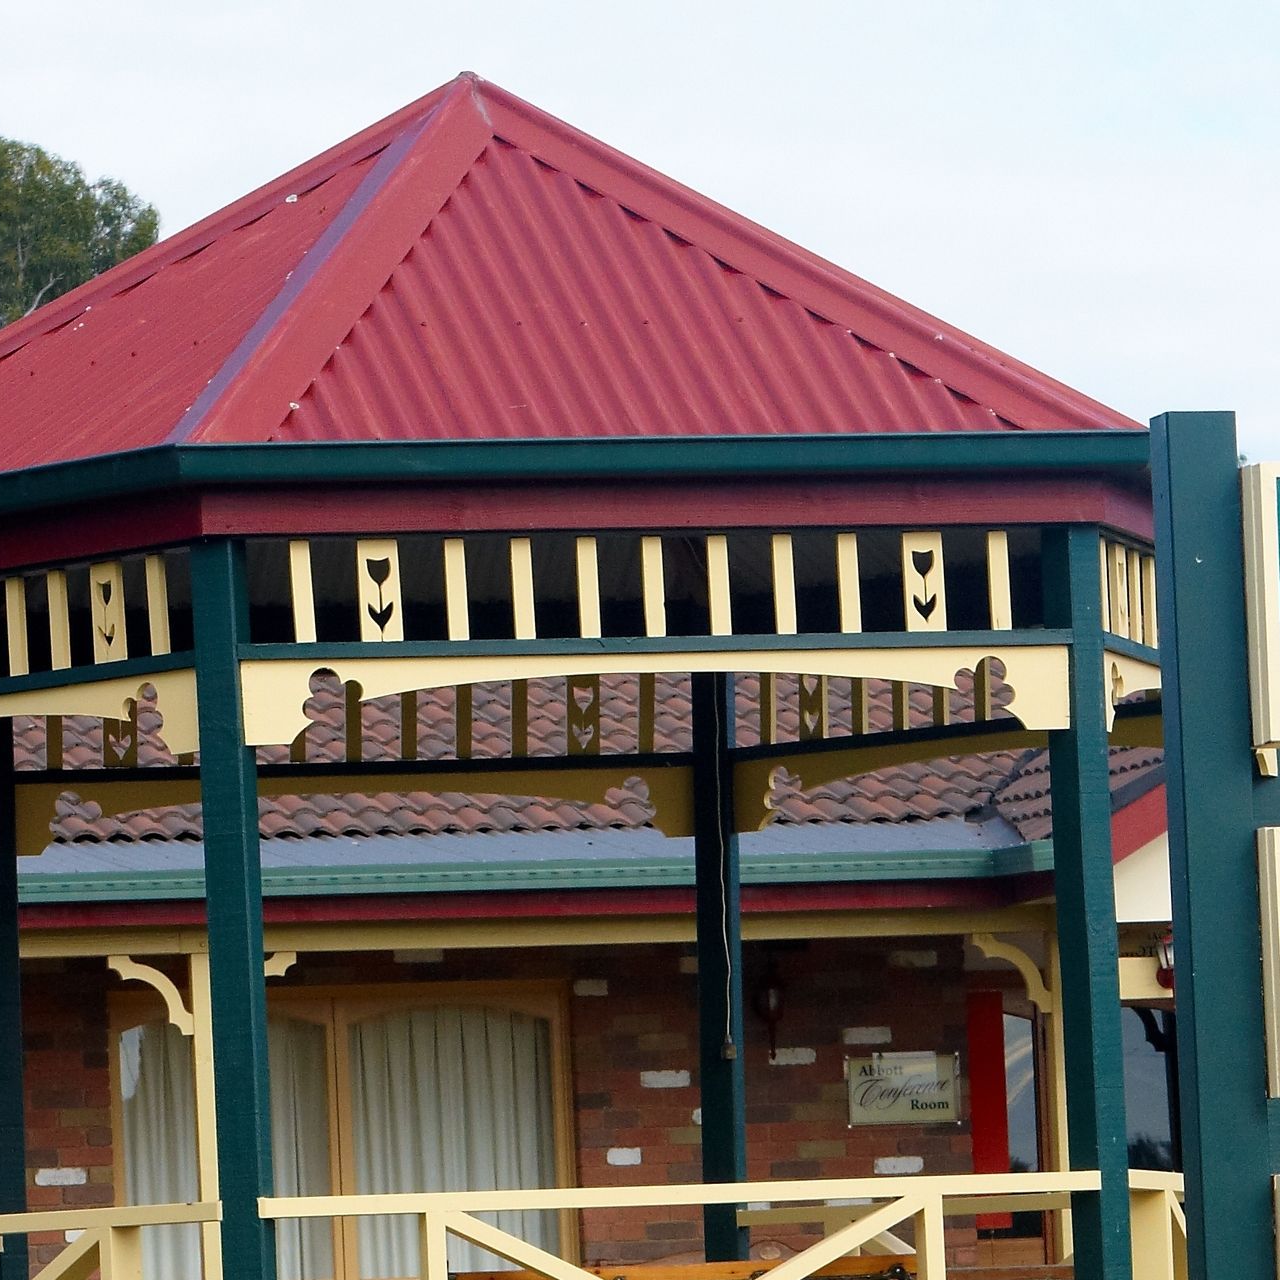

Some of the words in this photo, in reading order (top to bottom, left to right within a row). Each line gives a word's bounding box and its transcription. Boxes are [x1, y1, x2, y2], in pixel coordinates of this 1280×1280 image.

[859, 1064, 903, 1077] Abbott
[854, 1074, 949, 1110] Conference
[911, 1099, 949, 1110] Room
